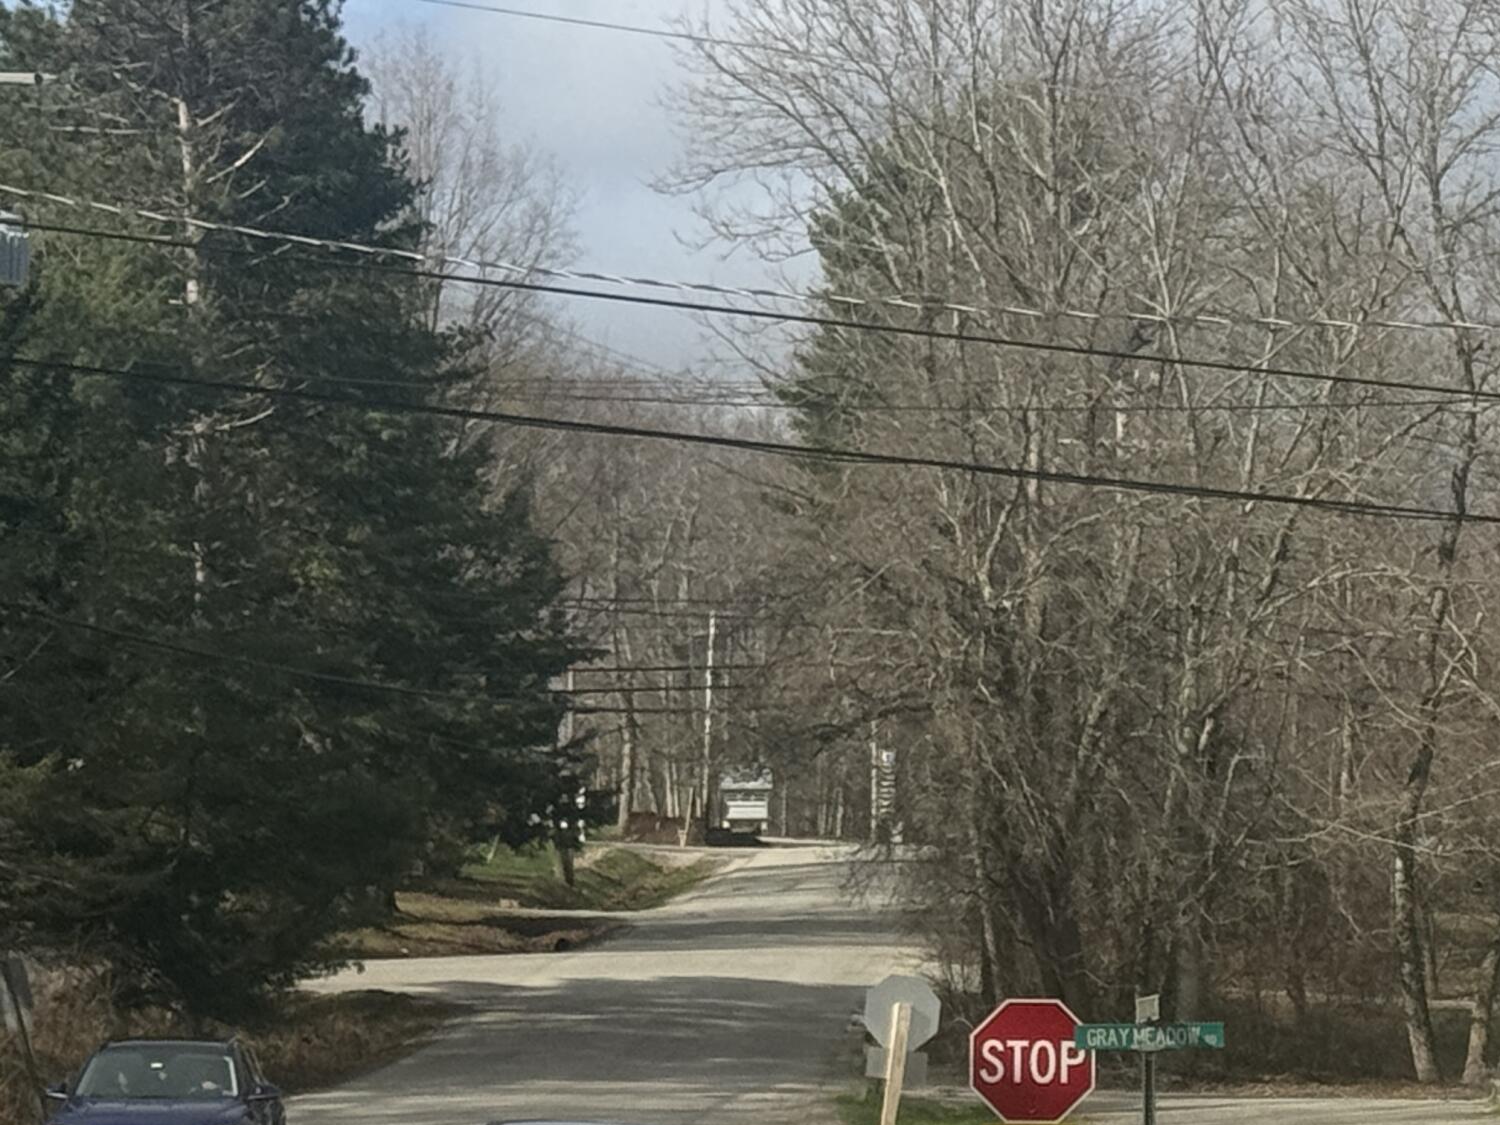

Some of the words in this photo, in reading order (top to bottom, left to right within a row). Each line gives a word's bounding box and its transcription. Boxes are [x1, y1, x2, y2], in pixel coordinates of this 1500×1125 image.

[1086, 1028, 1129, 1047] GRAY
[1132, 1026, 1200, 1047] MEADOW
[979, 1038, 1086, 1085] STOP
